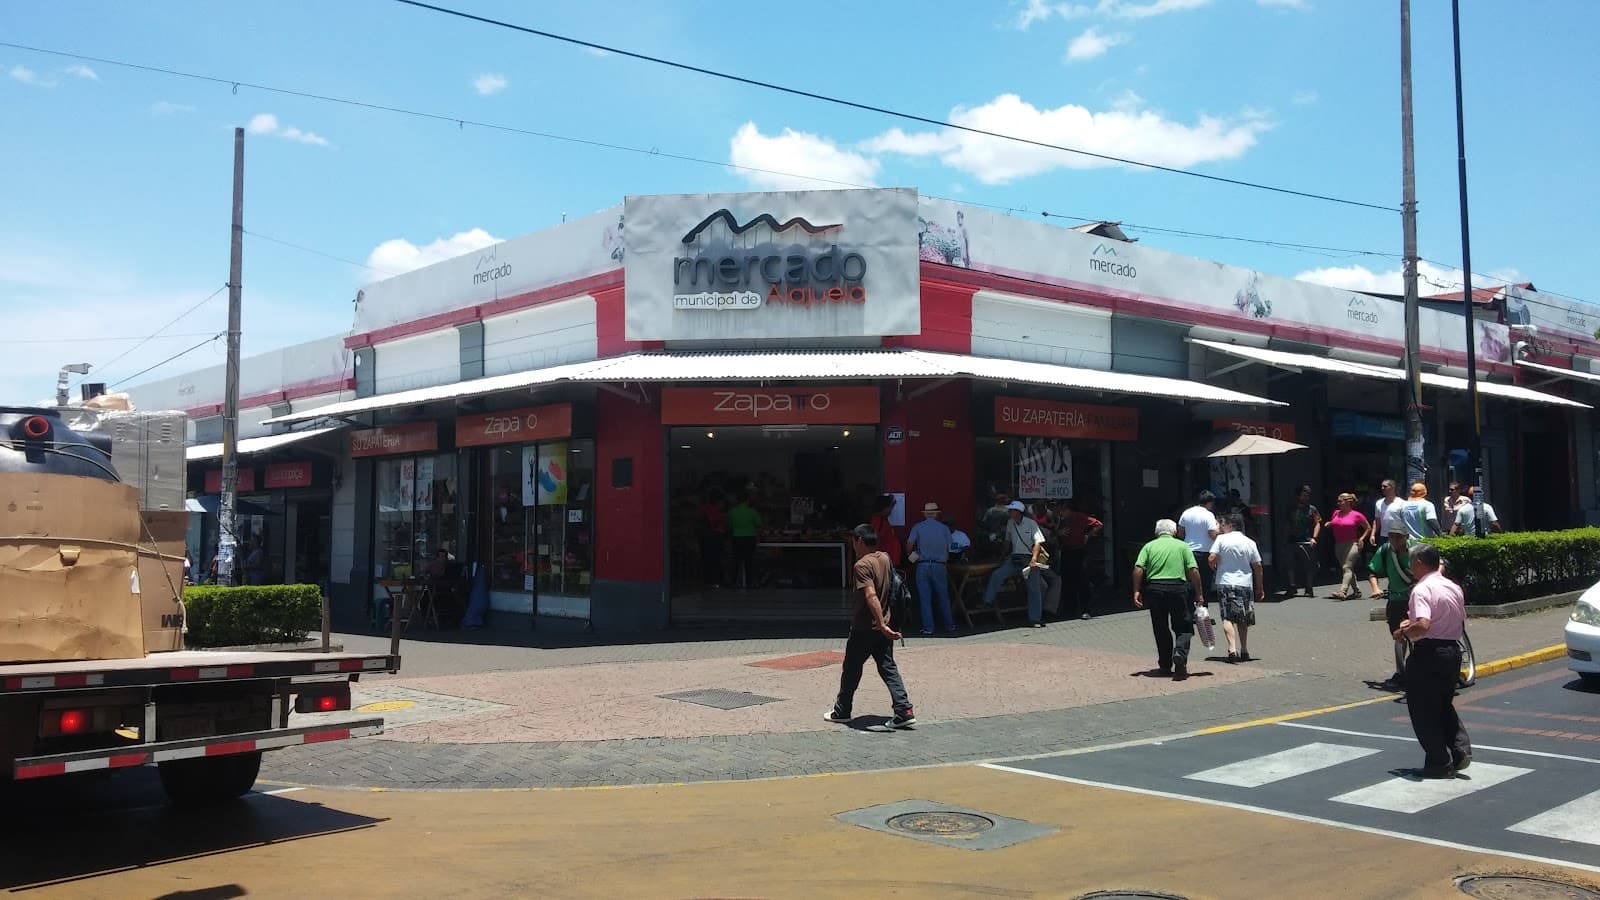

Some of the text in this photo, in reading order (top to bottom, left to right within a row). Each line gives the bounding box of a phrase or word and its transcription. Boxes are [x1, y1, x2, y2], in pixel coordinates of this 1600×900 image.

[473, 262, 511, 284] mercado
[673, 244, 867, 285] mercado
[1089, 258, 1137, 279] mercado
[675, 283, 866, 310] municipal de Alajuela
[1347, 308, 1378, 325] mercado
[1001, 406, 1020, 422] SU
[1022, 407, 1086, 427] ZAPATERÍA
